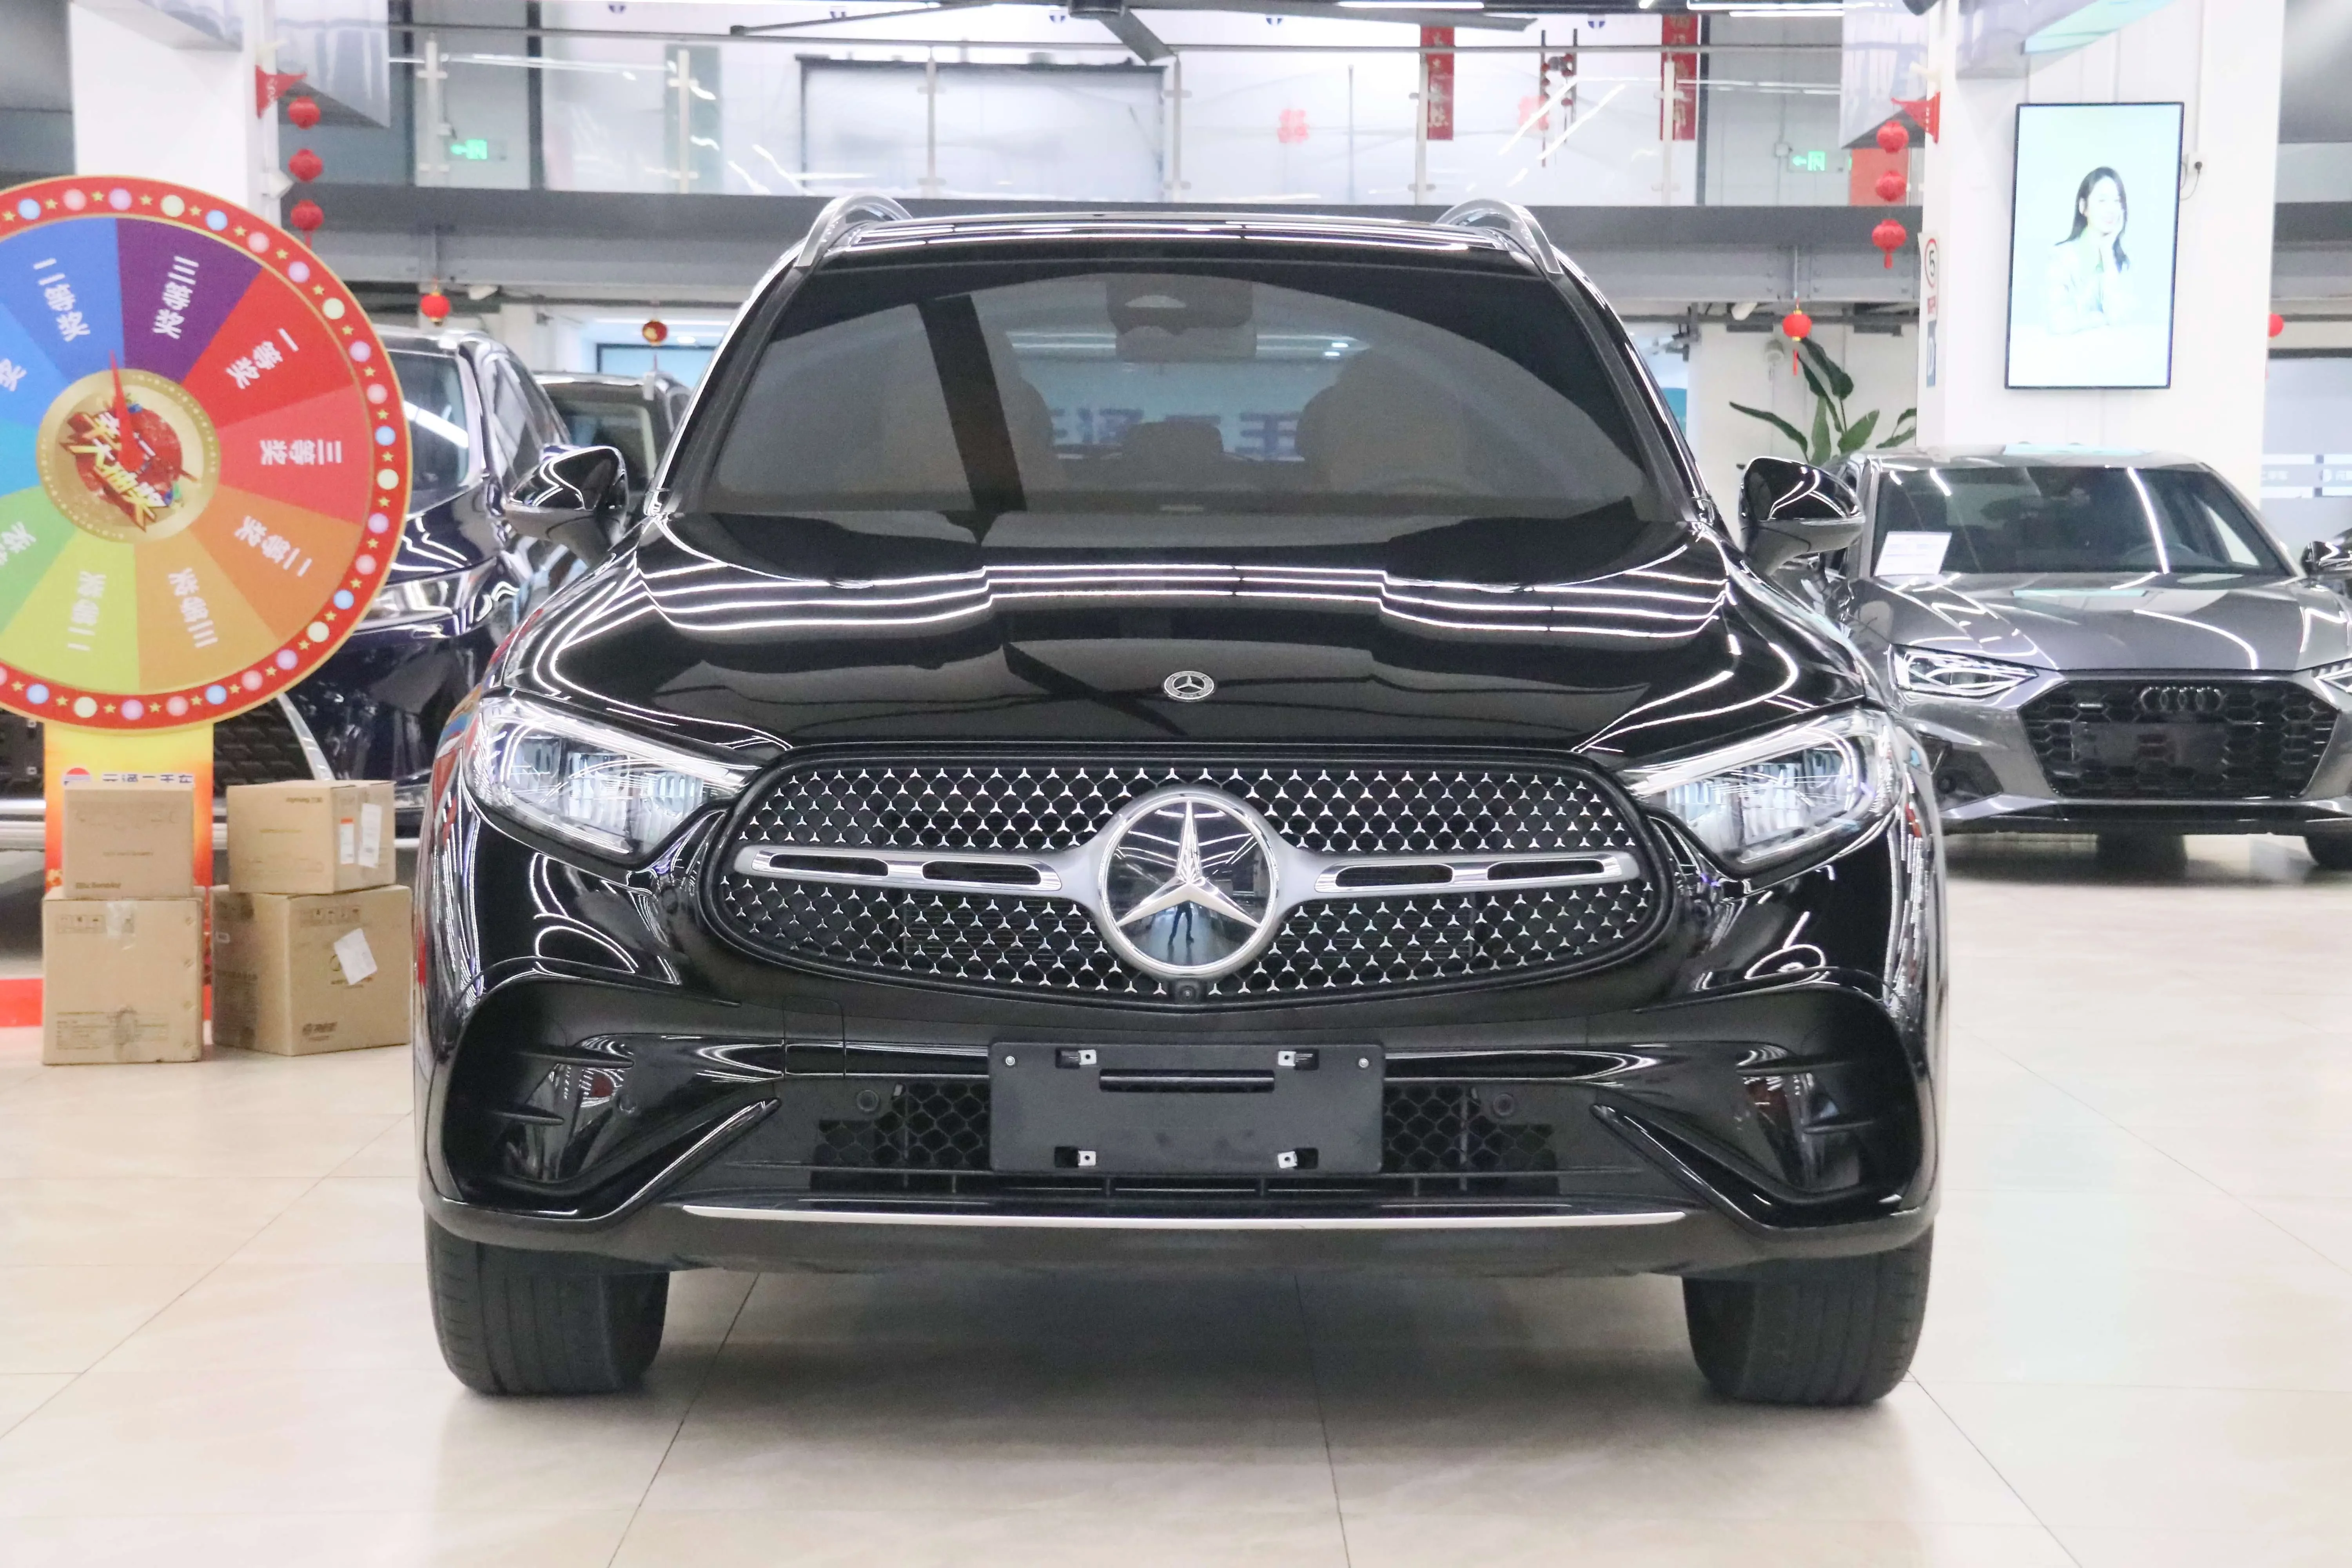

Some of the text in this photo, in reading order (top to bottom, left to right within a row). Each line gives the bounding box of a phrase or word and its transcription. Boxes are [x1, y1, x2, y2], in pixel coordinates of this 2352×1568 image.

[33, 258, 91, 342] 二等奖
[152, 256, 199, 339] 三等奖
[225, 328, 299, 390] 一等奖
[260, 439, 342, 465] 三等奖
[234, 515, 312, 577] 二等奖
[67, 571, 106, 651] 二等奖
[168, 567, 218, 648] 三等奖
